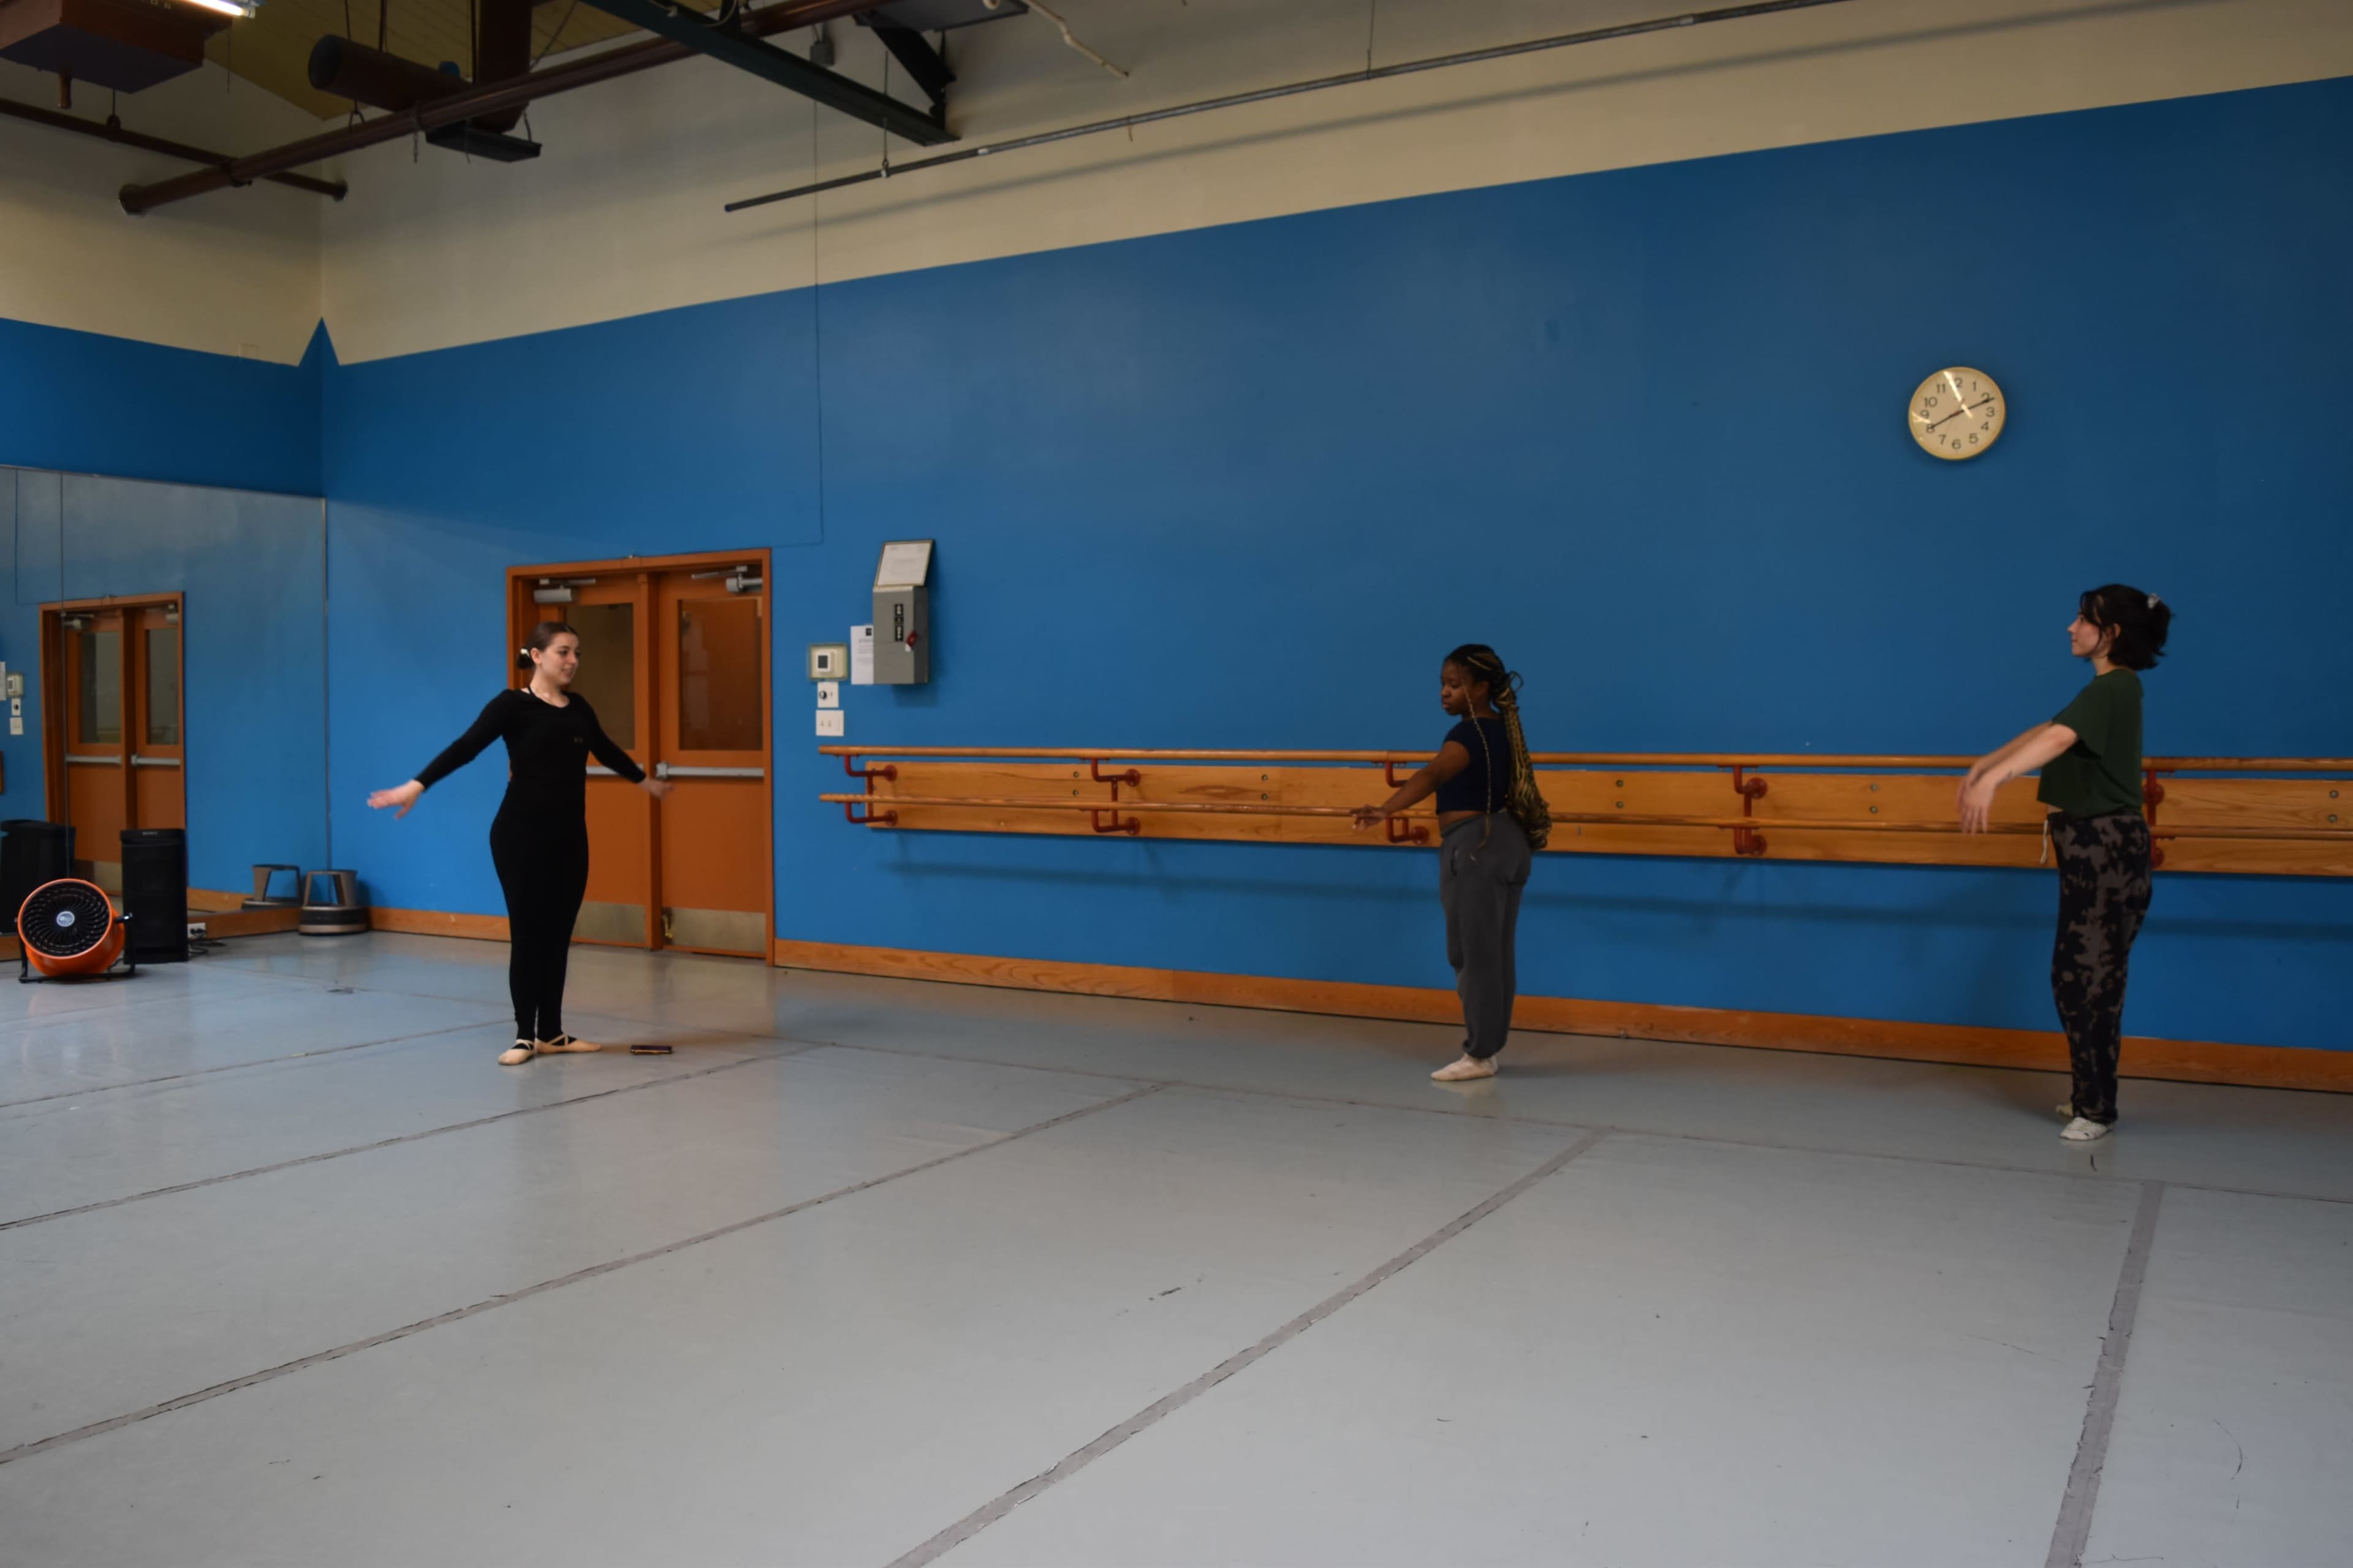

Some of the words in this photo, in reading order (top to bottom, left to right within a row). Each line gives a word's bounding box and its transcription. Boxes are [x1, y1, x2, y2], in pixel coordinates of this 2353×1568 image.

[1936, 384, 1946, 393] 11
[1972, 381, 1977, 392] 1
[1923, 396, 1938, 407] 10
[1920, 409, 1930, 419] 9
[1986, 407, 1995, 417] 3
[1926, 423, 1935, 434] 8
[1980, 422, 1989, 431] 4
[1938, 434, 1947, 445] 7
[1969, 433, 1979, 444] 5
[1952, 439, 1961, 450] 6
